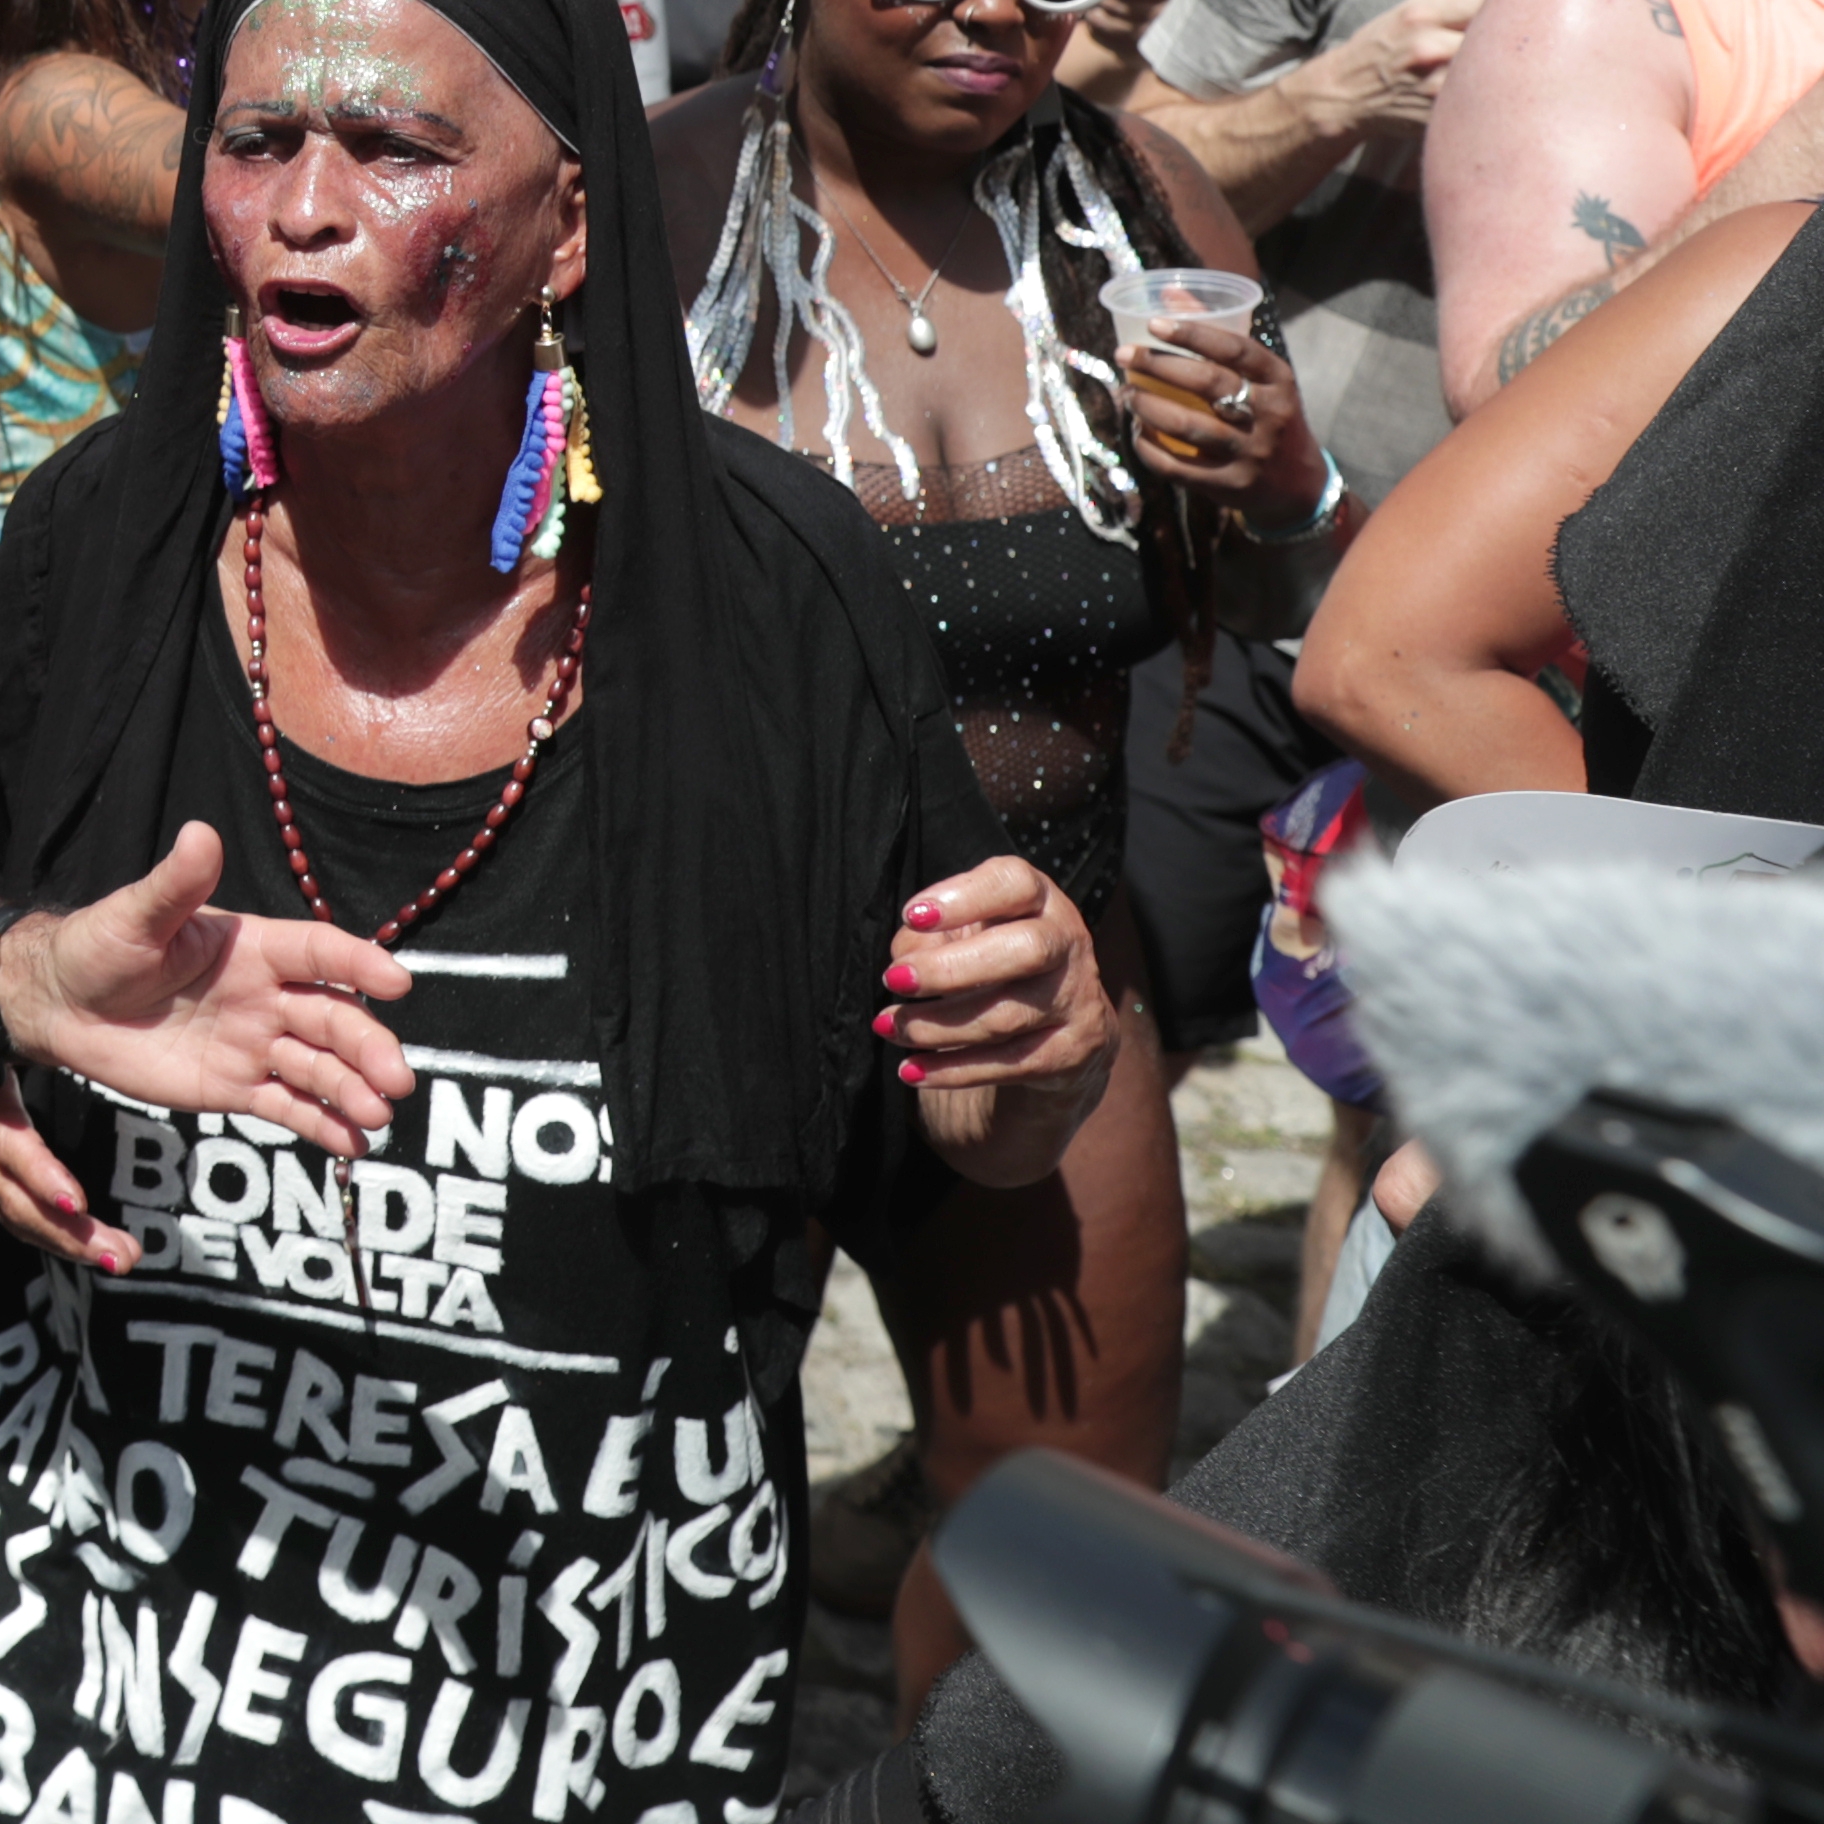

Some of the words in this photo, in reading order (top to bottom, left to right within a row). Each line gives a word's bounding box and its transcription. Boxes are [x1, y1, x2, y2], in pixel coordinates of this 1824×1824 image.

[109, 1107, 509, 1275] BONDE
[127, 1320, 559, 1517] TERESA
[73, 1589, 682, 1823] INSEGURO
[689, 1649, 789, 1772] E
